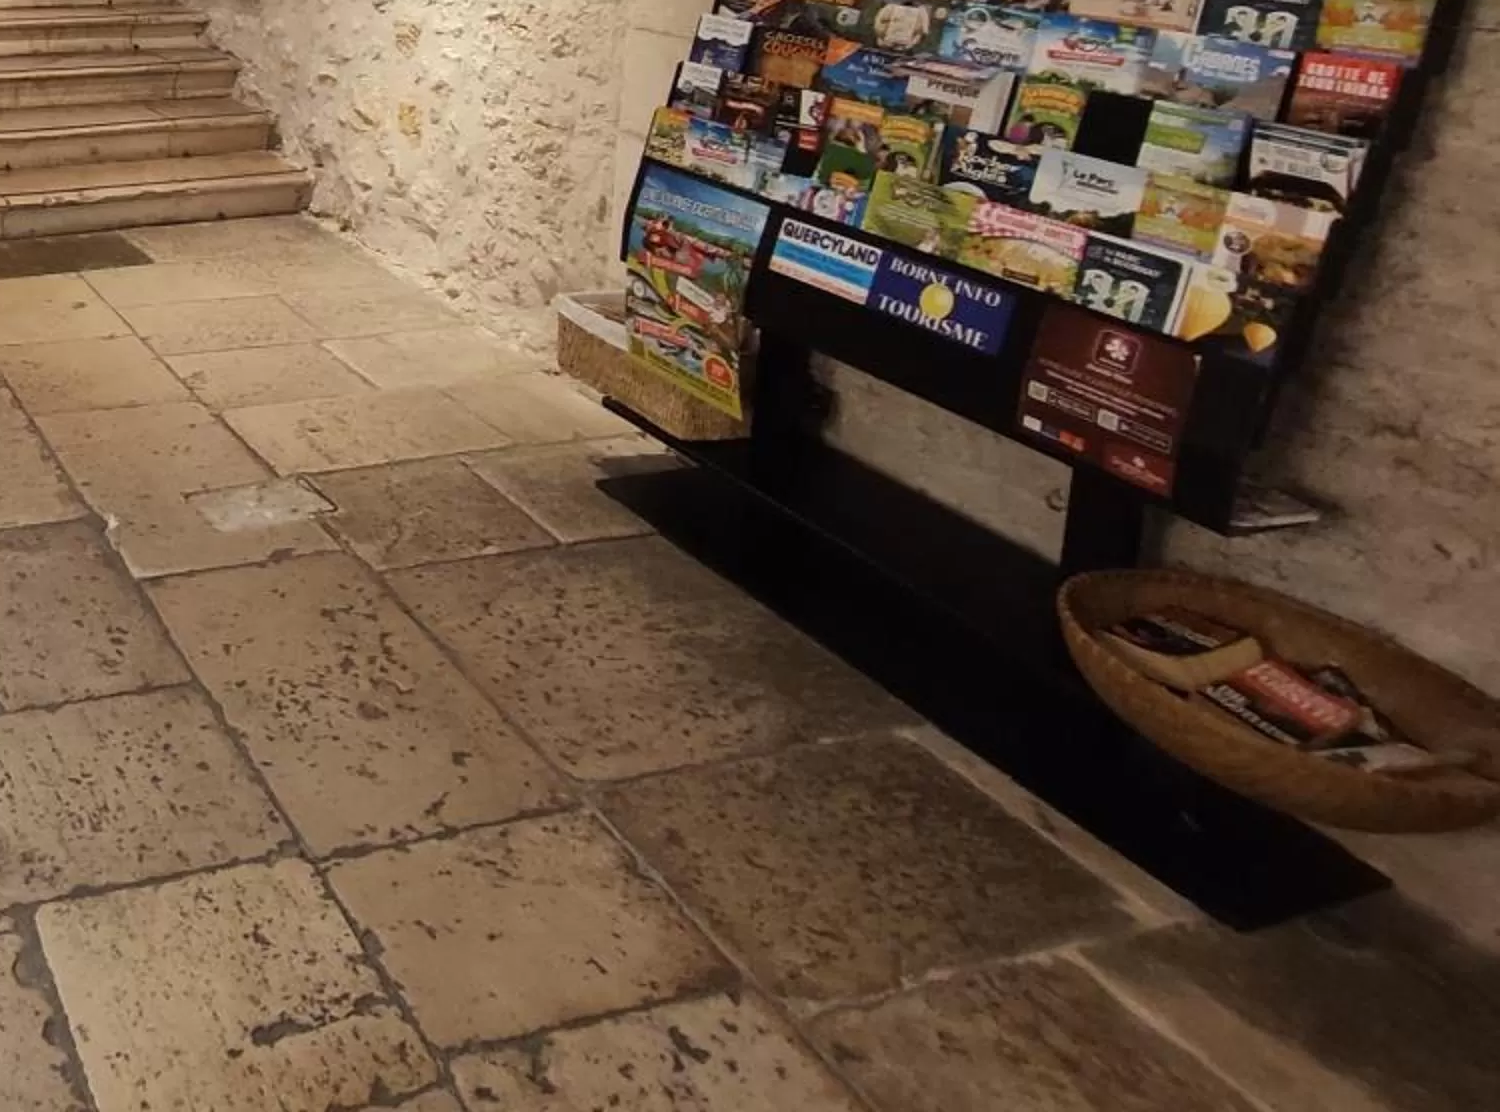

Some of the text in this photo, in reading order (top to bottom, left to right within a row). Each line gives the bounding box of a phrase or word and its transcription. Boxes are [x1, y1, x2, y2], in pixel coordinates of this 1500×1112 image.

[782, 223, 880, 268] QUERCYLAND
[889, 255, 950, 286] BORNE
[954, 277, 1002, 309] INFO
[878, 293, 990, 352] TOURISME
